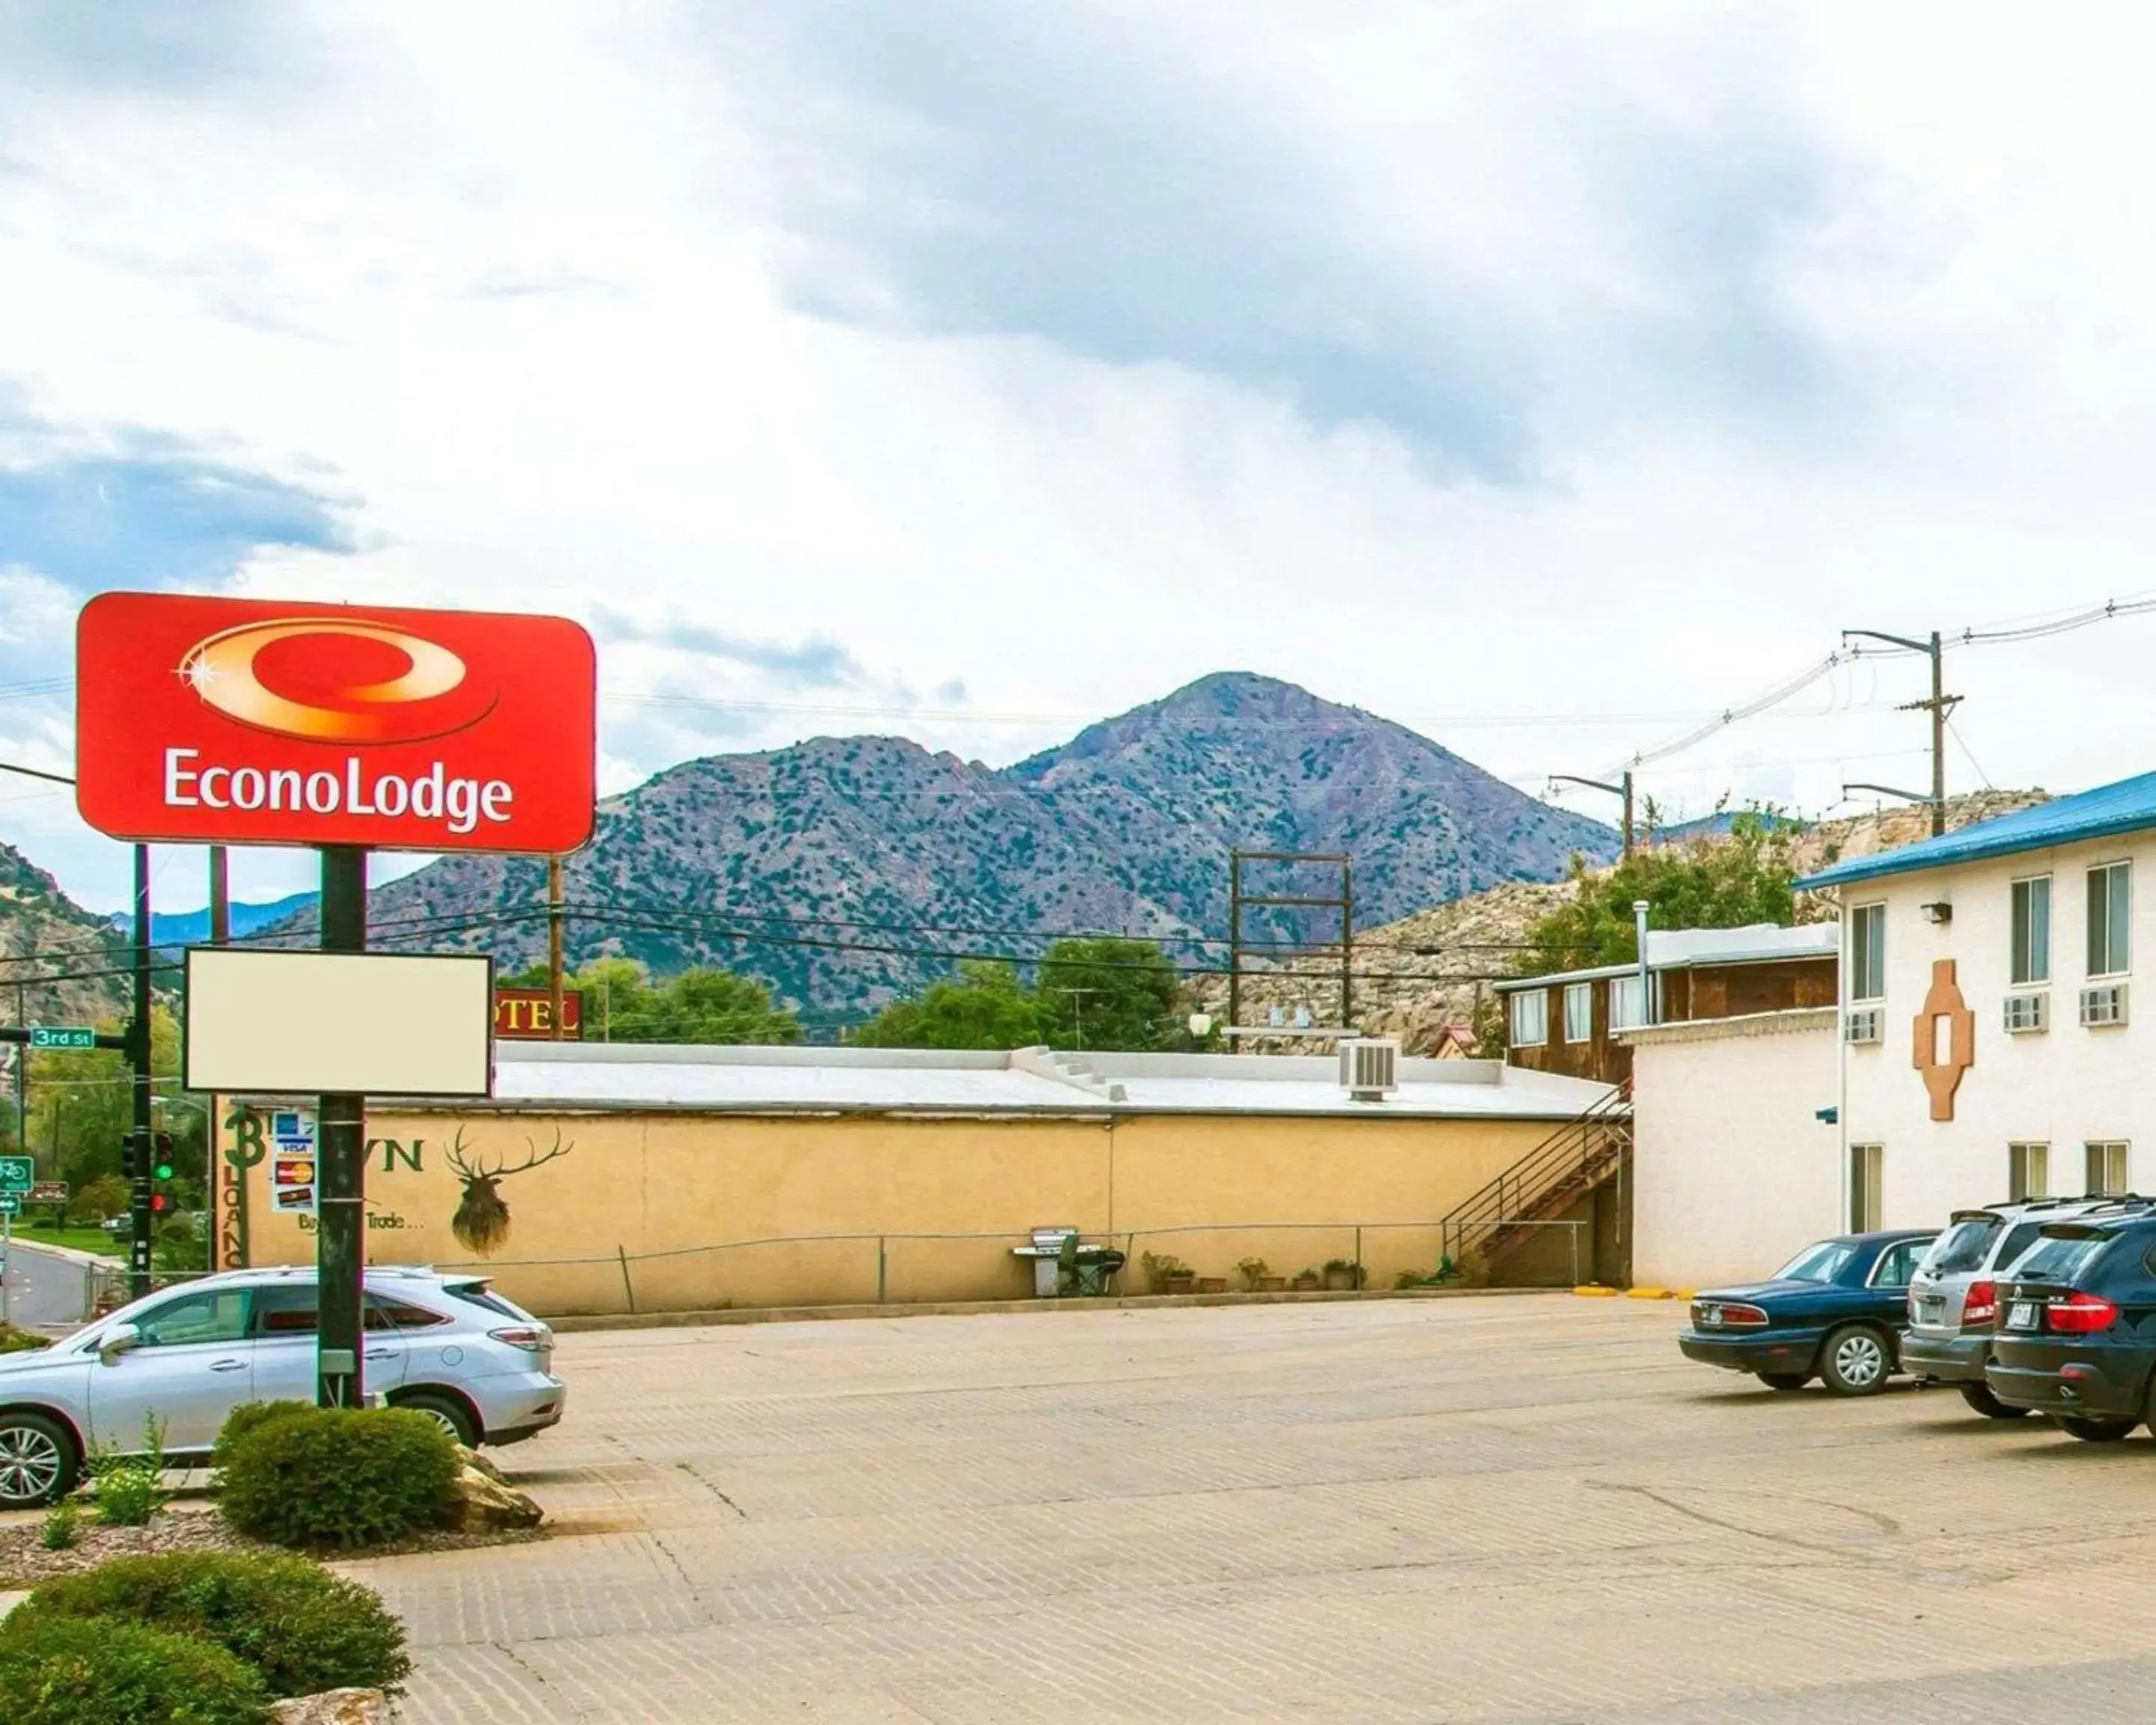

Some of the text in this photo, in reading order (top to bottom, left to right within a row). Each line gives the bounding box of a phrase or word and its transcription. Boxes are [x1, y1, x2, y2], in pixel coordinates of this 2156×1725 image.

[164, 747, 514, 834] EconoLodge
[494, 999, 579, 1030] TEL
[35, 1030, 89, 1045] 3rd St
